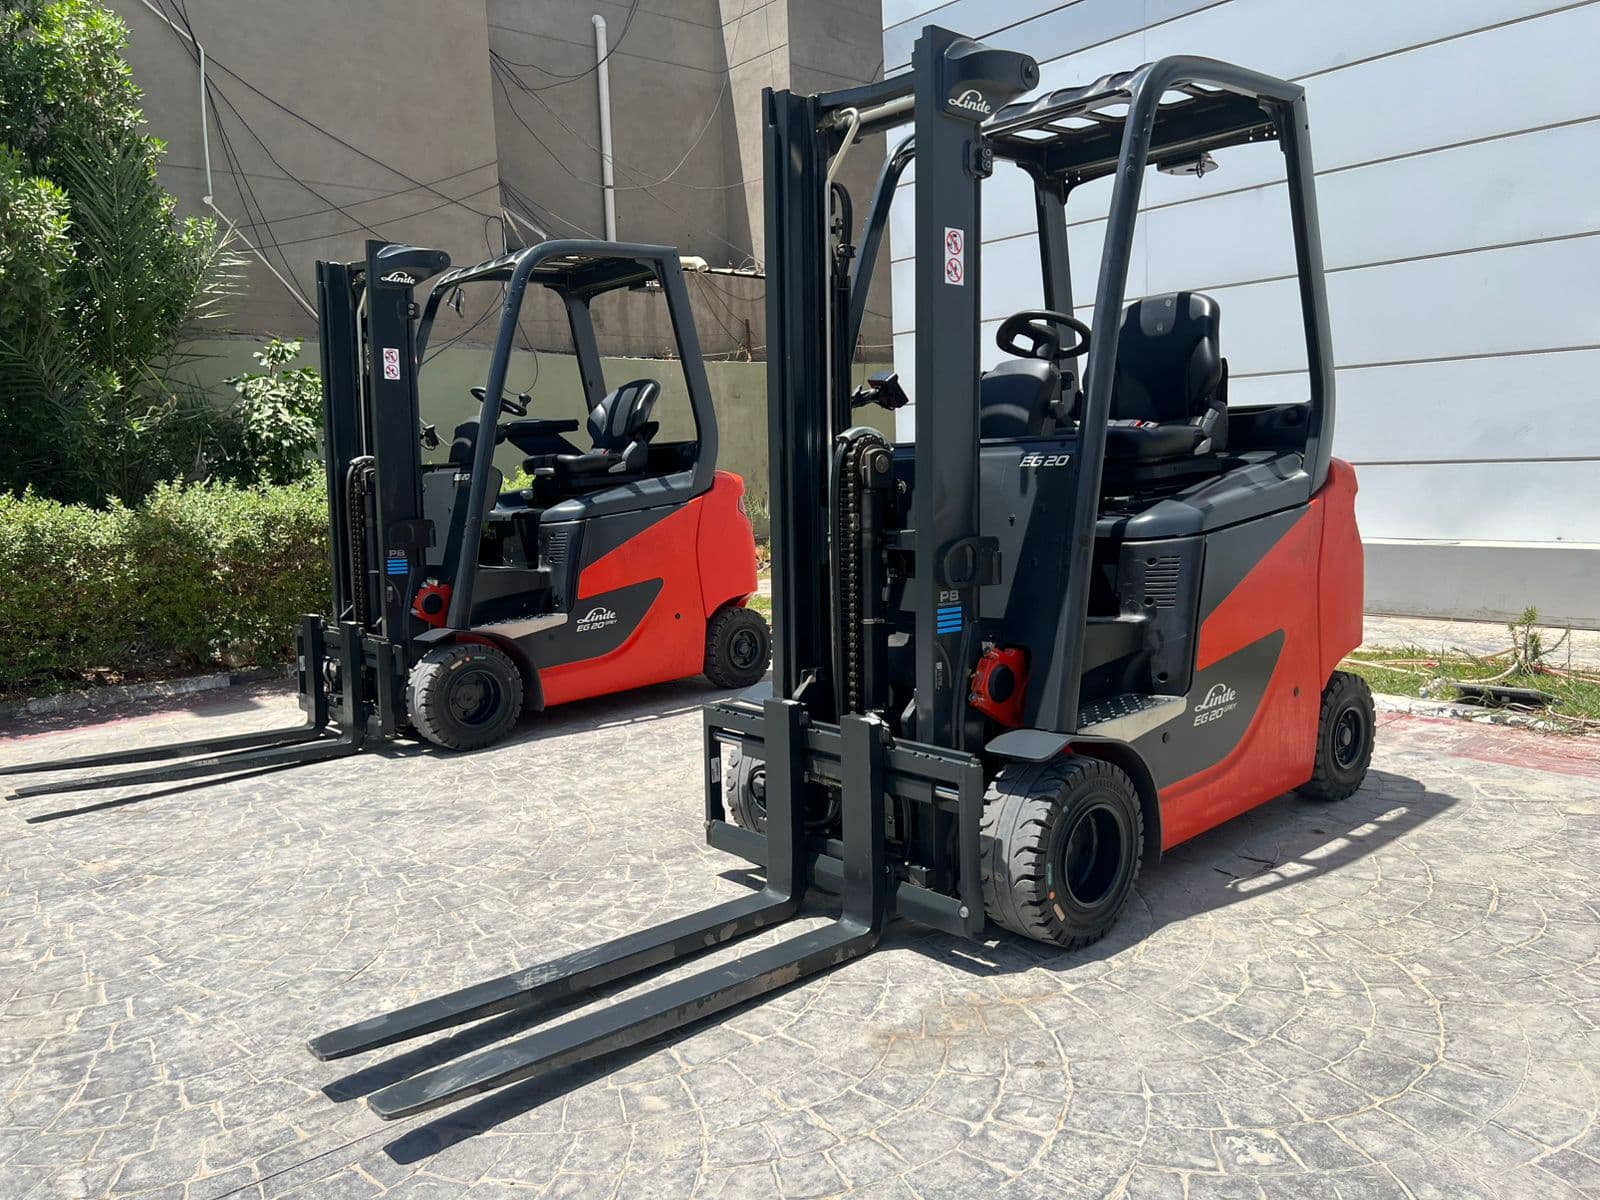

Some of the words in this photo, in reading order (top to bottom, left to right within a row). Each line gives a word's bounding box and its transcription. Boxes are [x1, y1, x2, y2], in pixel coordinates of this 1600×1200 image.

[948, 89, 991, 114] Linde
[380, 271, 416, 284] Linde
[1019, 455, 1045, 467] EG
[1043, 455, 1070, 467] 20
[576, 607, 617, 624] Linde
[590, 621, 605, 630] 20
[1194, 683, 1236, 712] Linde
[1193, 712, 1210, 727] EG
[1209, 707, 1224, 721] 20
